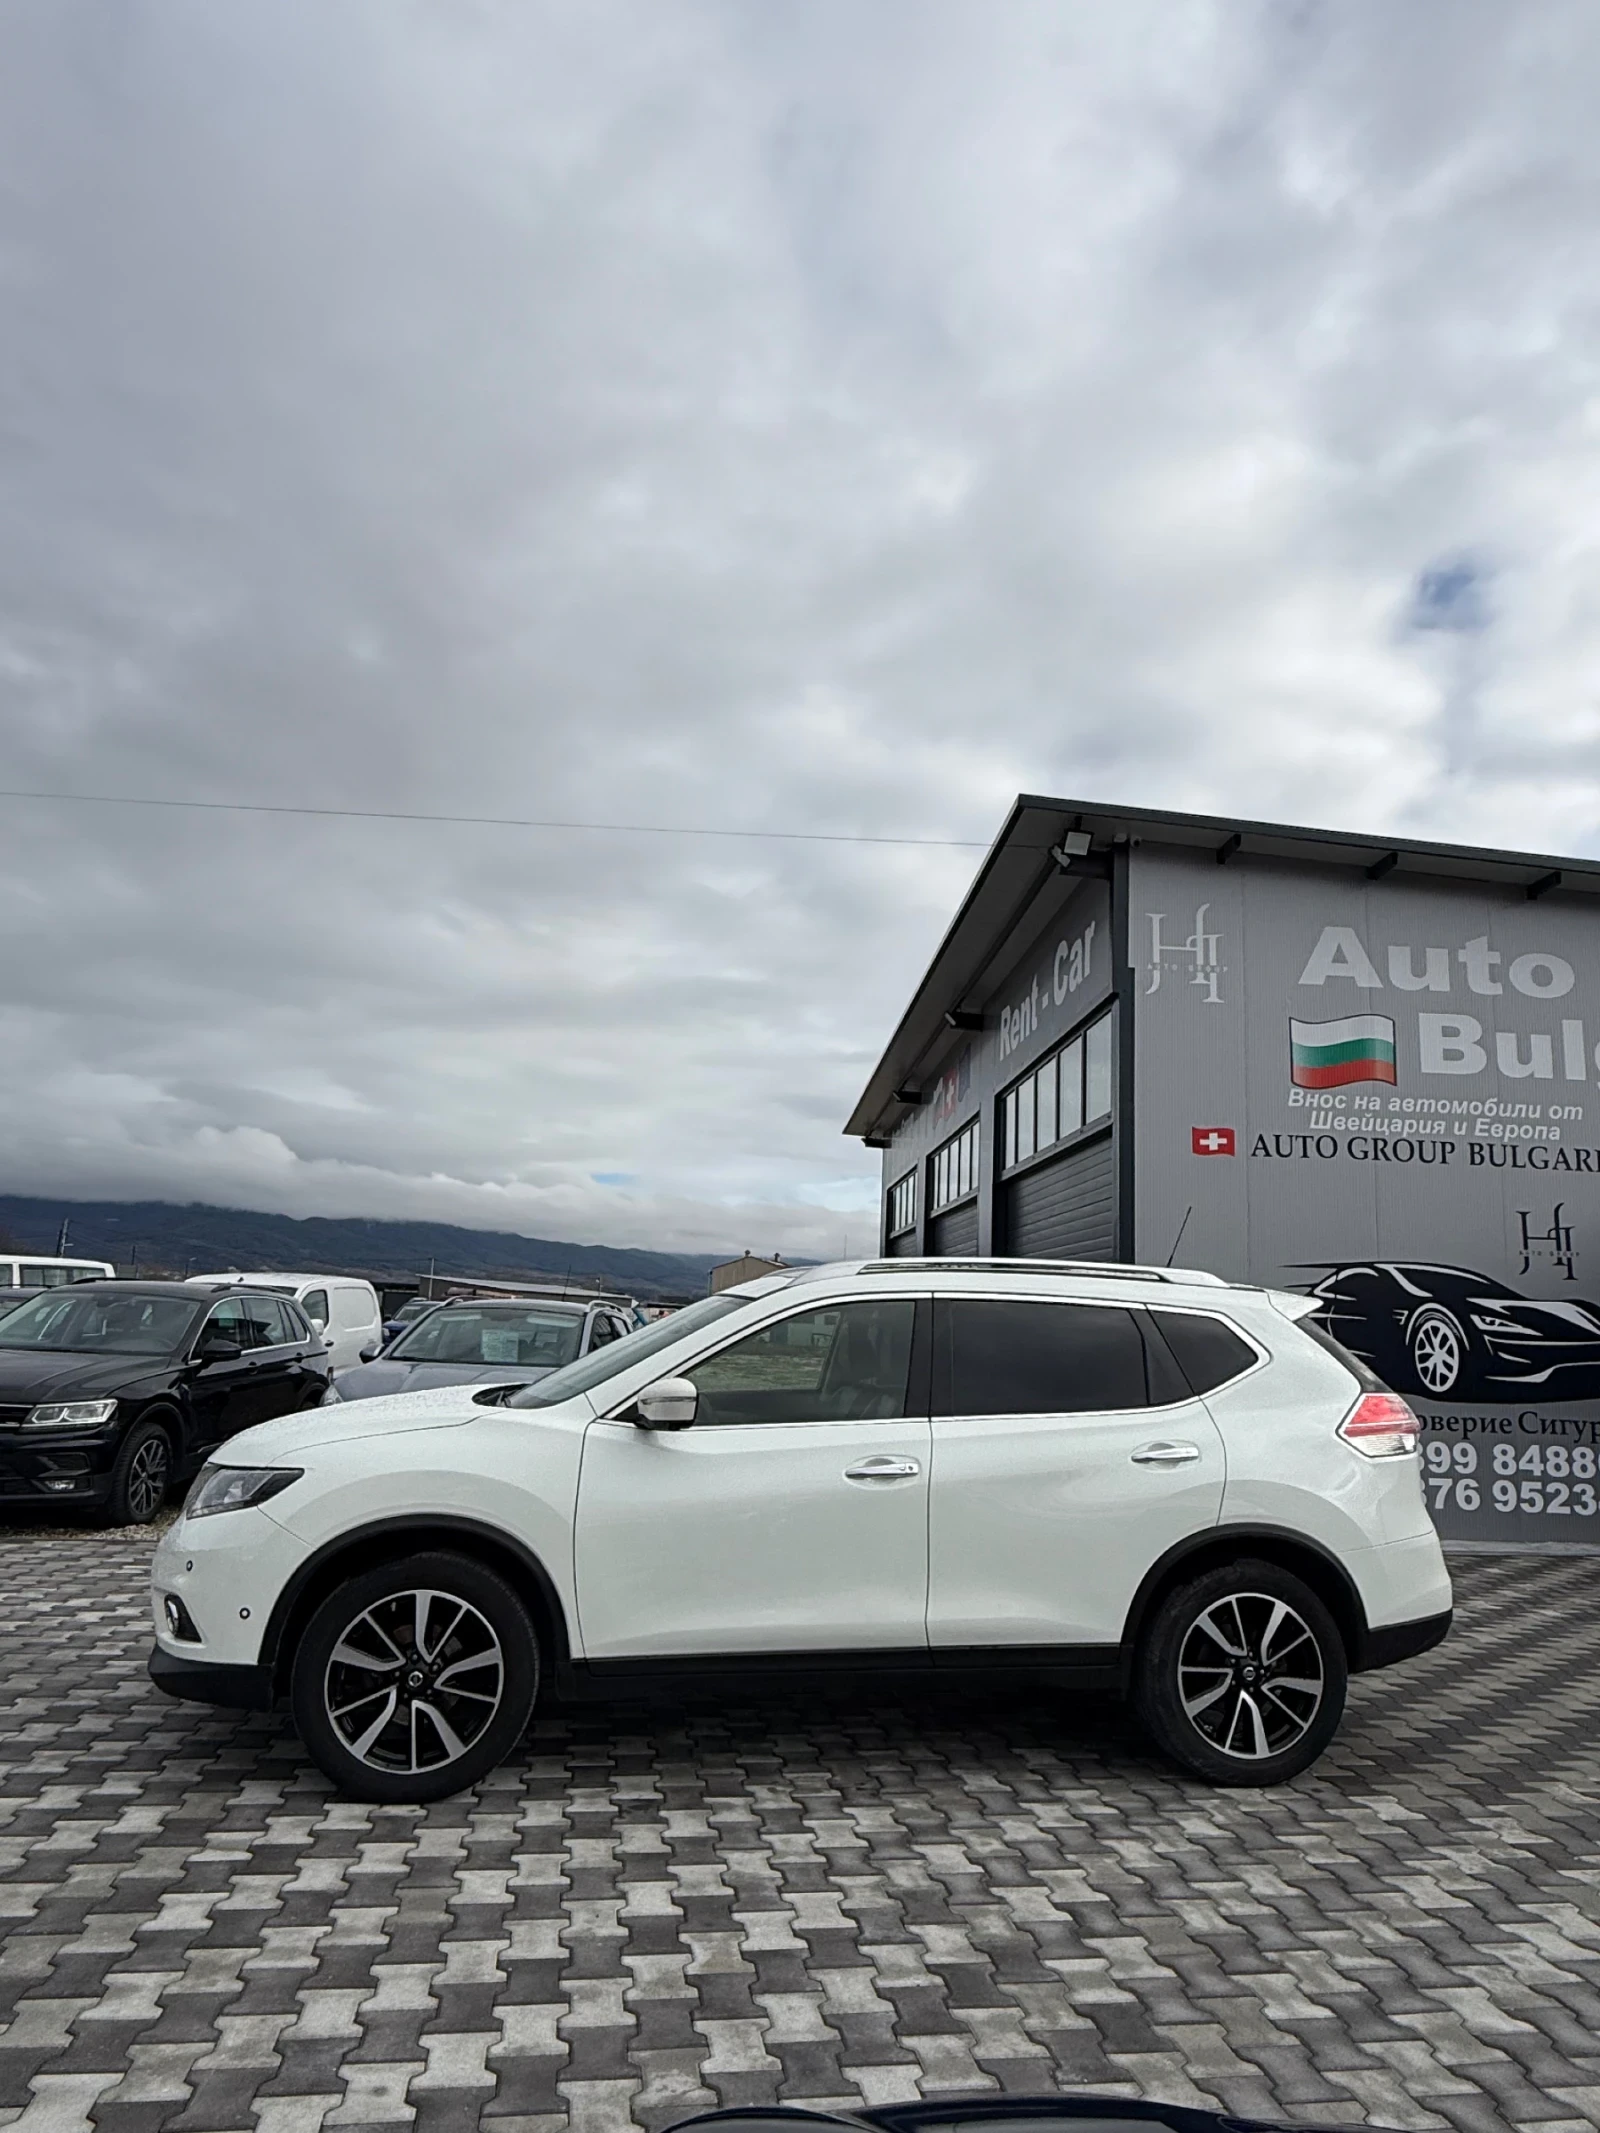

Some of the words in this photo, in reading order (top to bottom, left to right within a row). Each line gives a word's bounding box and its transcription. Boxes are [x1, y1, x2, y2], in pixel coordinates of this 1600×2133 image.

[1298, 926, 1575, 998] Auto
[1000, 973, 1039, 1061] Rent
[1054, 920, 1096, 1006] Car
[1288, 1088, 1347, 1108] Внос
[1354, 1096, 1381, 1111] на
[1388, 1096, 1541, 1119] автомобили
[1548, 1105, 1583, 1121] от
[1309, 1110, 1446, 1137] Швейцария
[1453, 1121, 1468, 1136] и
[1474, 1118, 1561, 1143] Европа
[1251, 1133, 1338, 1159] AUTO
[1347, 1136, 1455, 1164] GROUP
[1418, 1441, 1478, 1475] 99
[1492, 1443, 1600, 1479] 8488
[1420, 1478, 1481, 1511] 76
[1492, 1480, 1600, 1516] 9523
